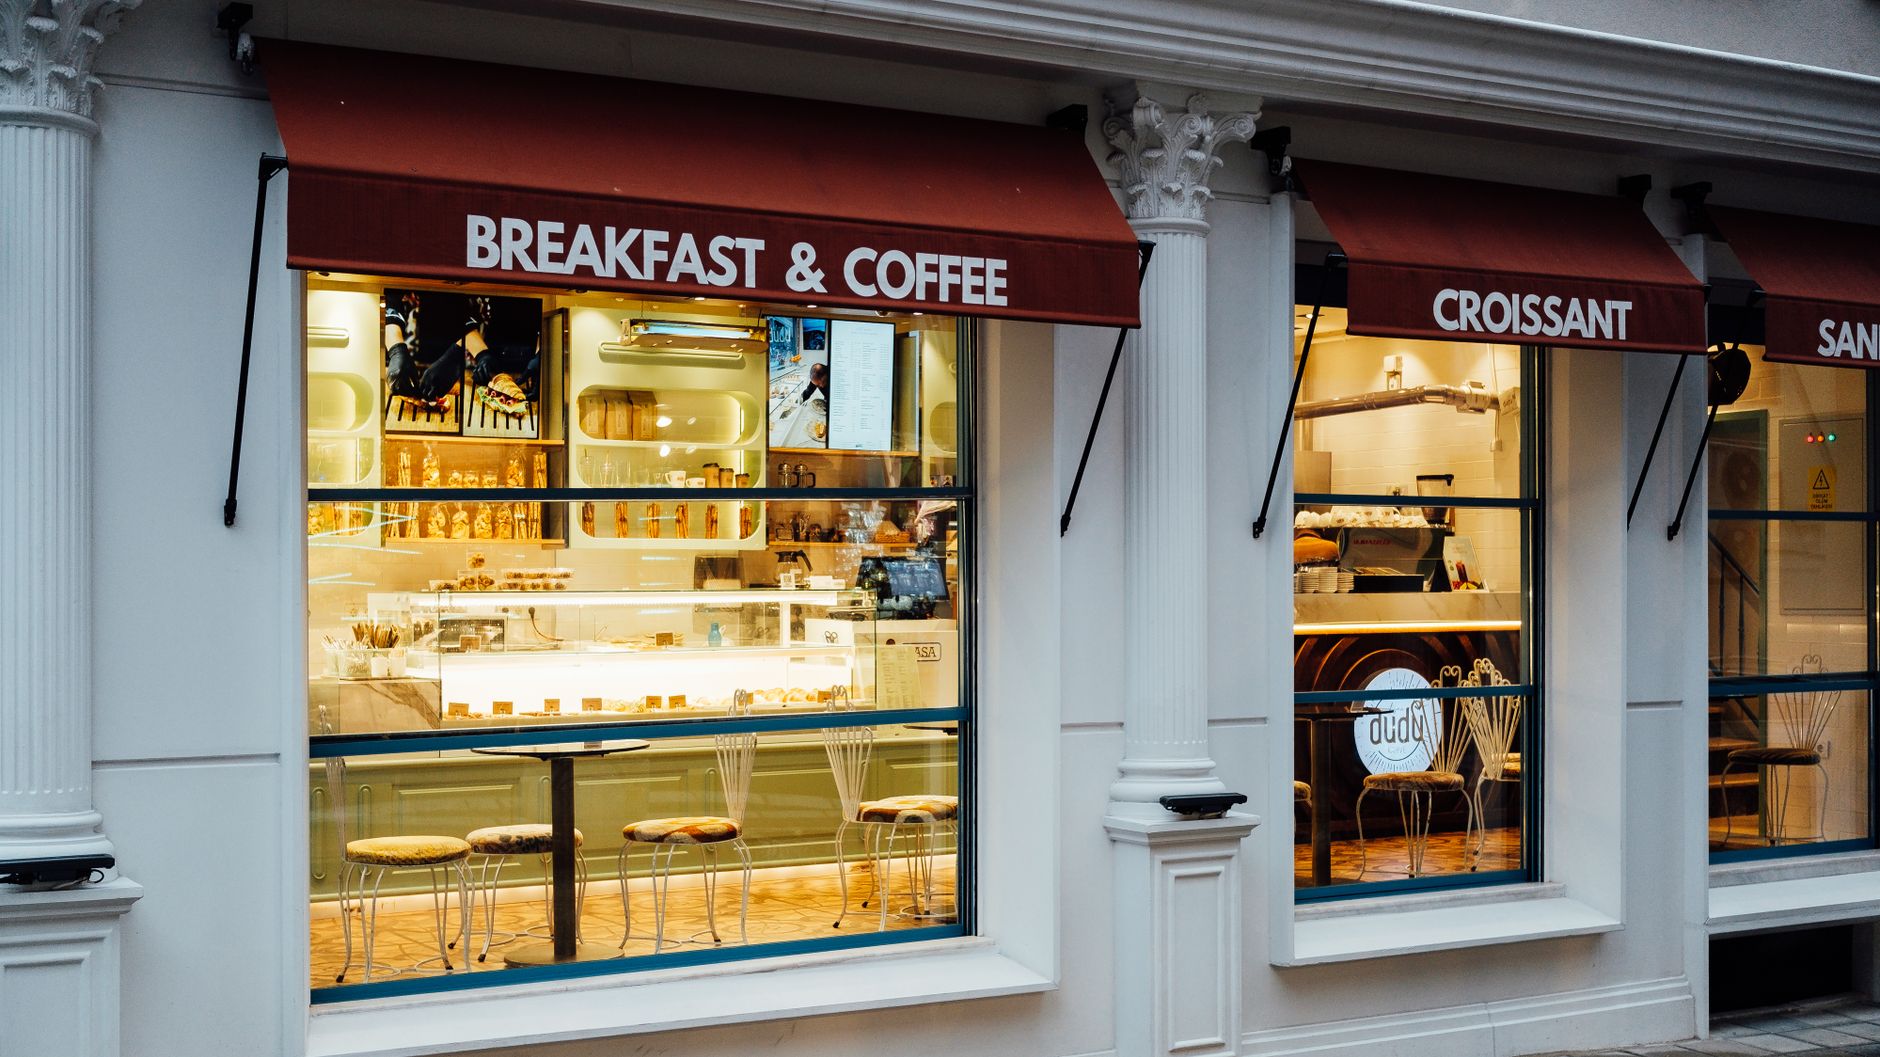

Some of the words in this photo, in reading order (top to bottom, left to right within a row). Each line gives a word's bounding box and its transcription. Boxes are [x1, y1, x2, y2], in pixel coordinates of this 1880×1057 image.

[466, 214, 766, 290] BREAKFAST
[785, 241, 828, 294] &
[843, 246, 1008, 308] COFFEE
[1432, 288, 1634, 341] CROISSANT
[1817, 318, 1880, 360] SAN
[914, 646, 937, 658] ASA
